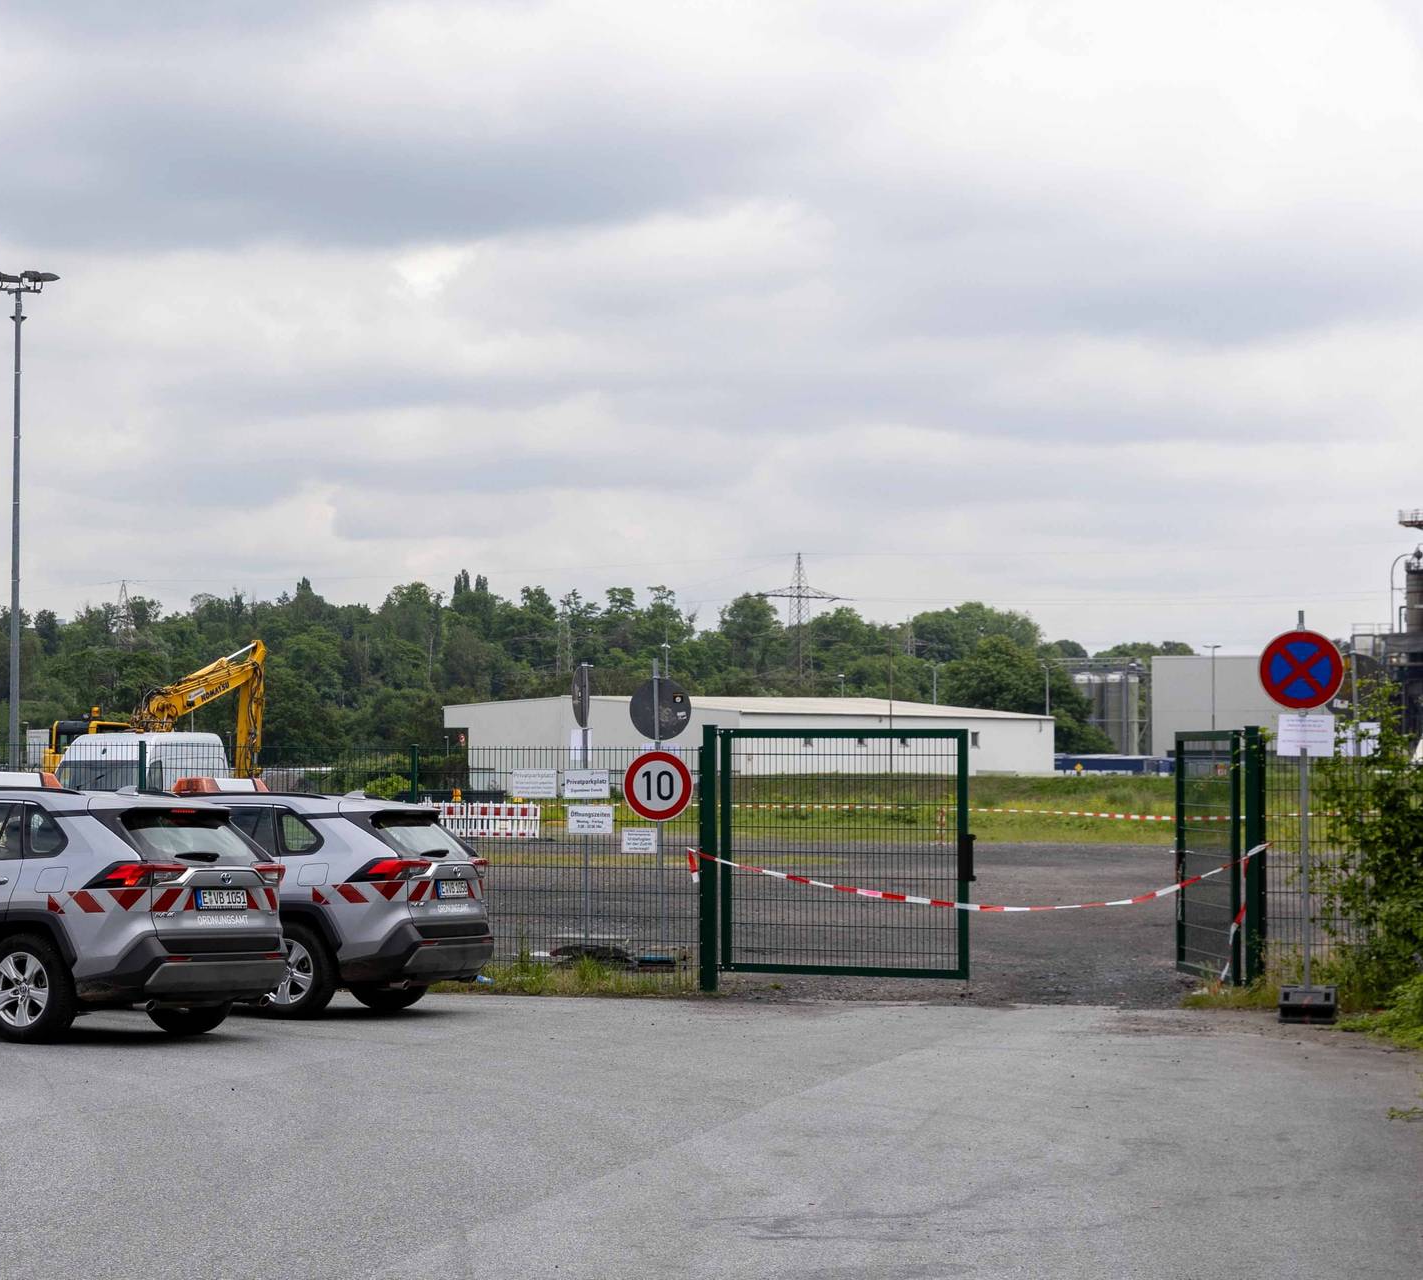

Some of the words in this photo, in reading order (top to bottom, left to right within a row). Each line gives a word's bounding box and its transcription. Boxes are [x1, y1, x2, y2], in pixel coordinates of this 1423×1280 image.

[201, 681, 230, 702] KOMATSU
[566, 778, 607, 786] Privatparkplatz
[642, 770, 674, 801] 10
[570, 810, 611, 818] Öffnungszeiten
[202, 891, 209, 904] E
[213, 890, 225, 904] VB
[227, 890, 247, 904] 1051
[197, 914, 249, 926] ORDNUNGSAMT
